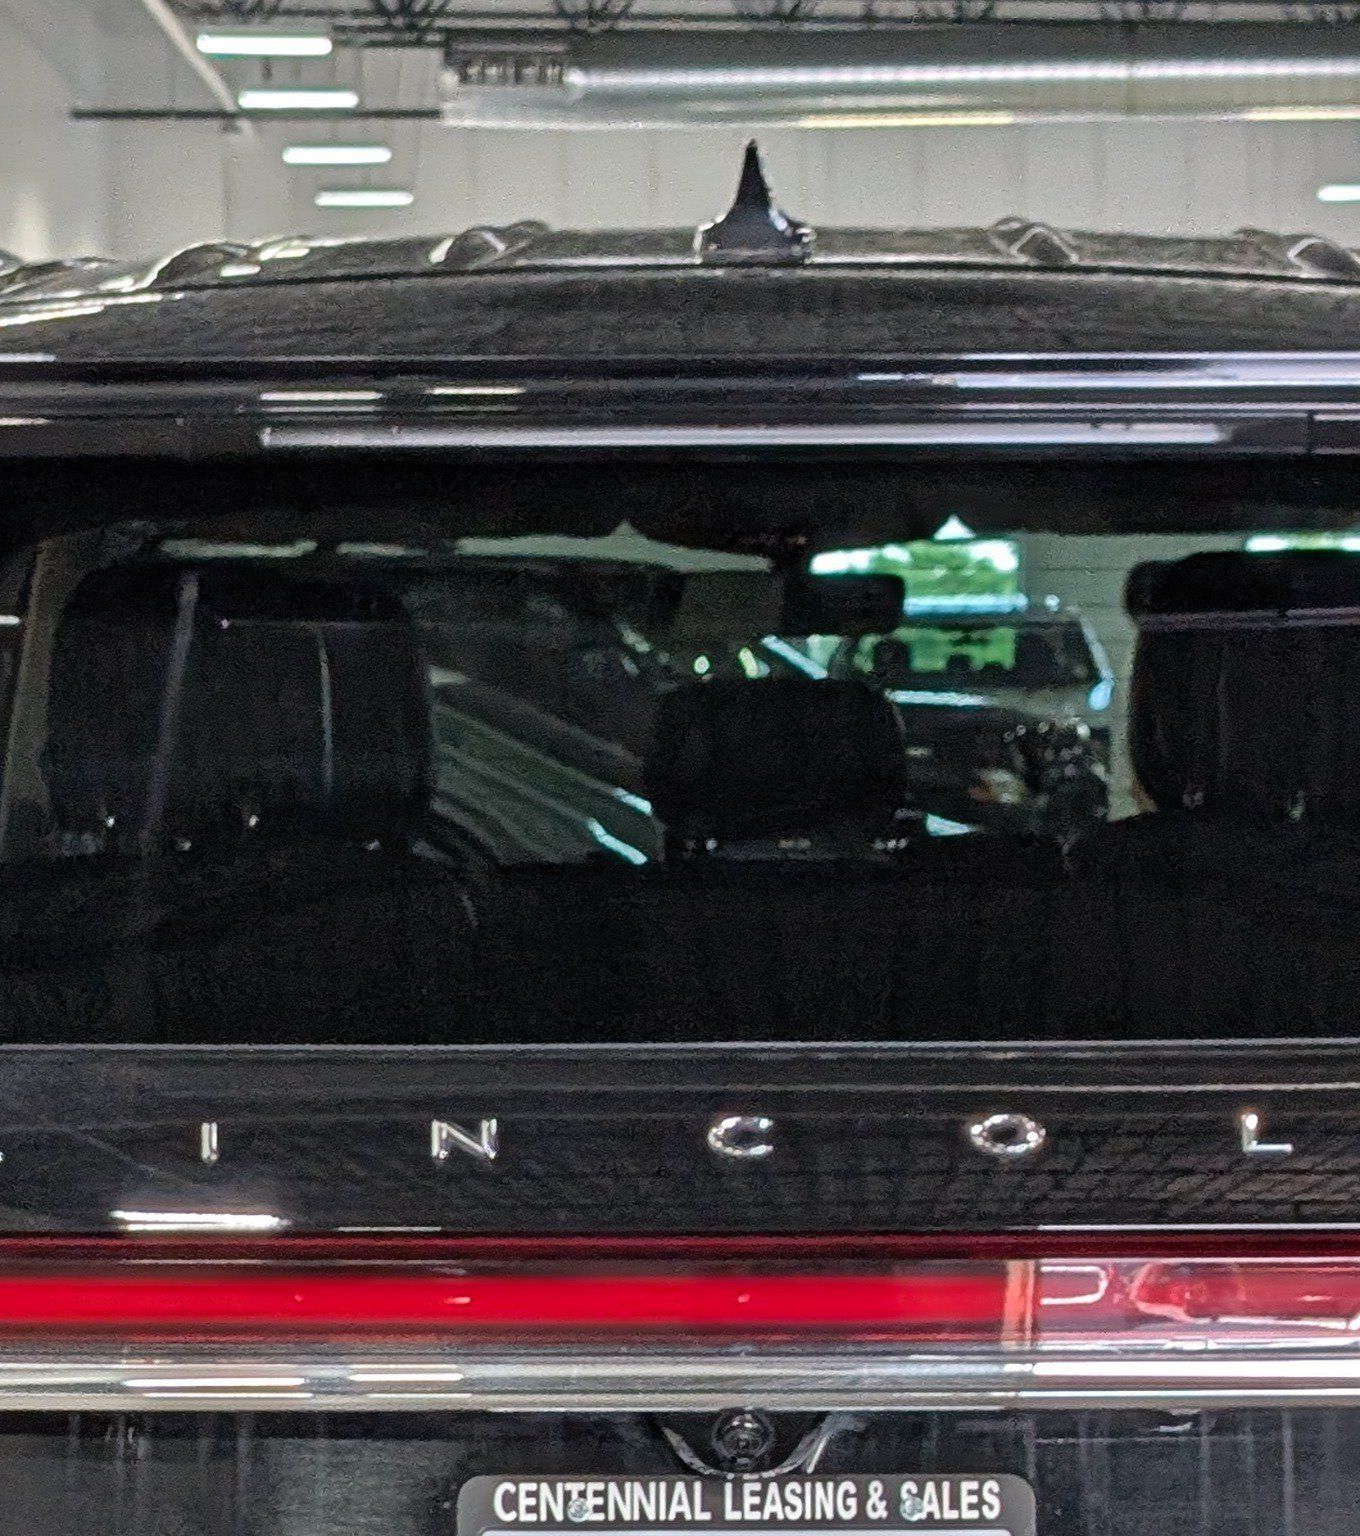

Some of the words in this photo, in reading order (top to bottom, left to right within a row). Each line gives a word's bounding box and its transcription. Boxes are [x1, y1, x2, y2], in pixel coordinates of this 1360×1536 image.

[493, 1482, 711, 1521] CENTENNIAL
[724, 1481, 857, 1520] LEASING
[867, 1481, 889, 1520] &
[900, 1480, 1001, 1520] SALES
